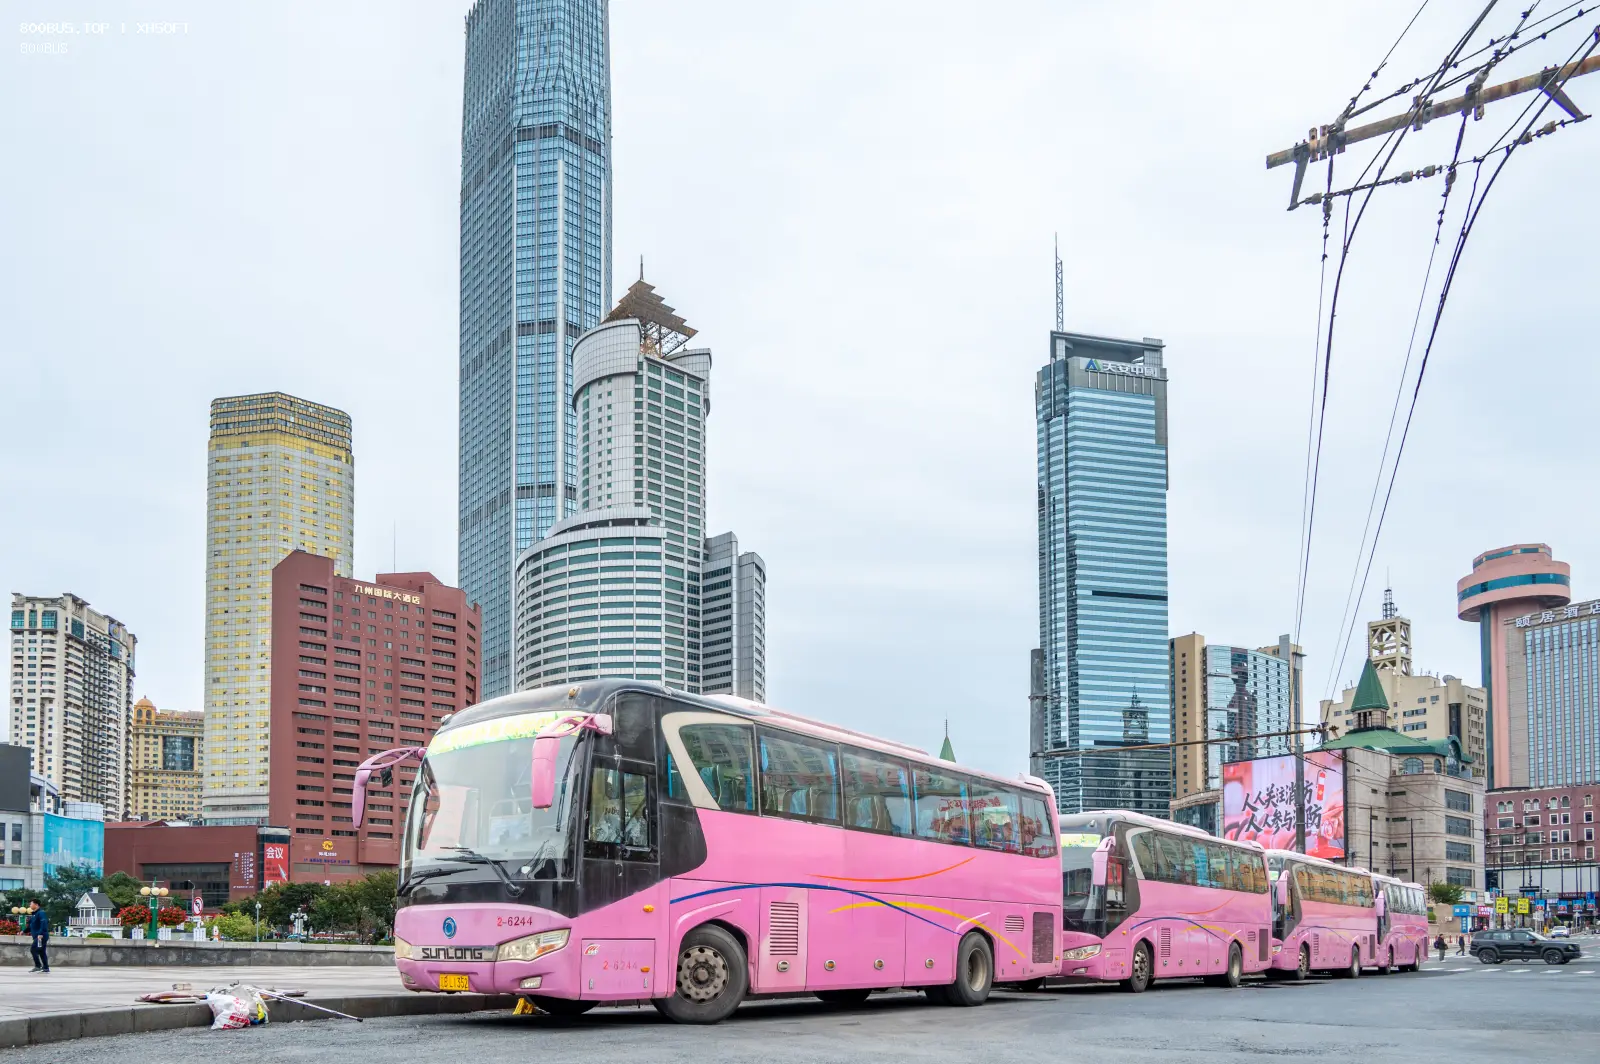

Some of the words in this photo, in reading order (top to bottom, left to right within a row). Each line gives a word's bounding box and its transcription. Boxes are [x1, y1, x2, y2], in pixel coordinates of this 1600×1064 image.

[355, 584, 420, 605] 九州国际大酒店
[1244, 803, 1323, 835] 人人参与防
[266, 846, 284, 860] 会议
[497, 916, 533, 927] 2-6244
[421, 947, 483, 960] SUNLONG
